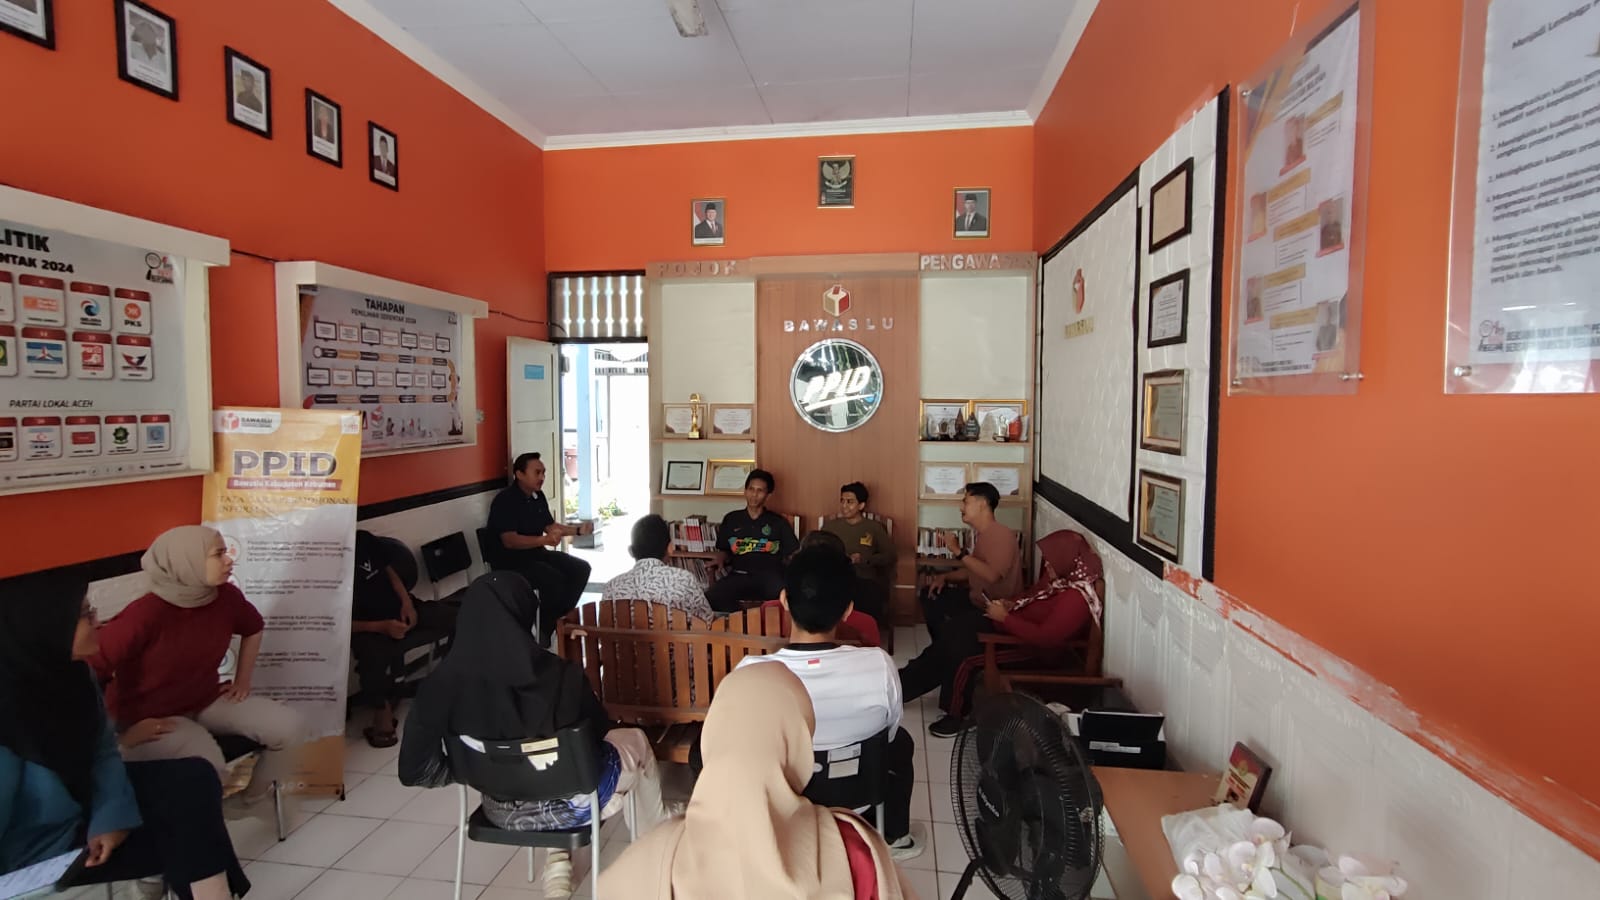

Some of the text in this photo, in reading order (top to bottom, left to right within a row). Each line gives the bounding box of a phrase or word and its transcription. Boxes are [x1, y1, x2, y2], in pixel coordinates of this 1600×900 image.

[41, 259, 75, 274] 2024
[365, 298, 405, 315] TAHAPAN
[124, 319, 142, 328] PKS
[783, 318, 894, 332] BAWASLU
[802, 365, 871, 404] PPID
[9, 399, 94, 408] PARTAI LOKAL ACEH
[233, 449, 338, 477] PPID
